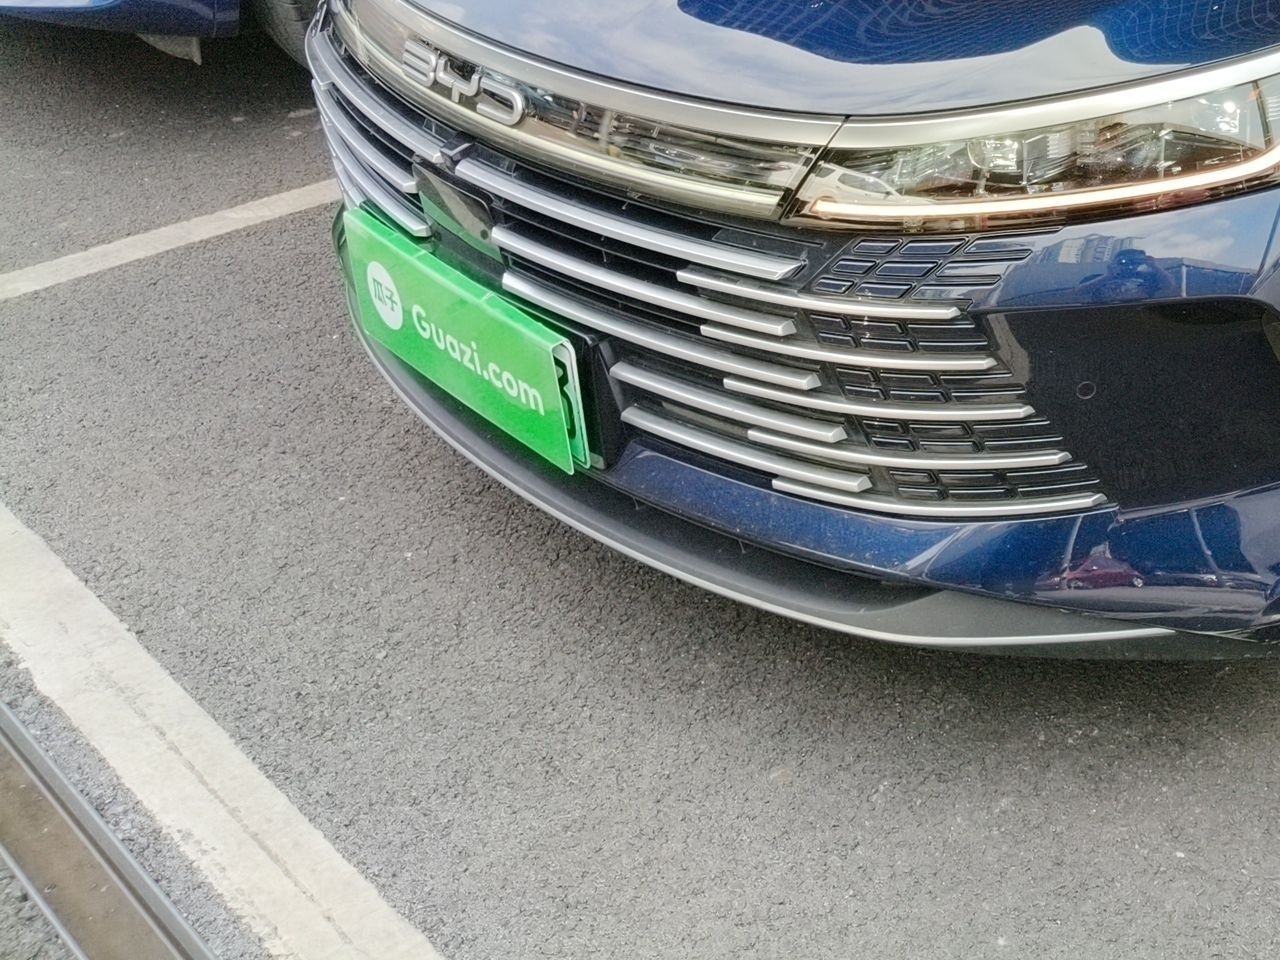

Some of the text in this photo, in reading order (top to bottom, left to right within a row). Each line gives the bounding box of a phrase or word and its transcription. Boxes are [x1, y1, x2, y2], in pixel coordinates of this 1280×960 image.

[402, 38, 526, 126] BYD
[372, 277, 398, 312] 瓜子
[411, 304, 545, 416] Guazi.com
